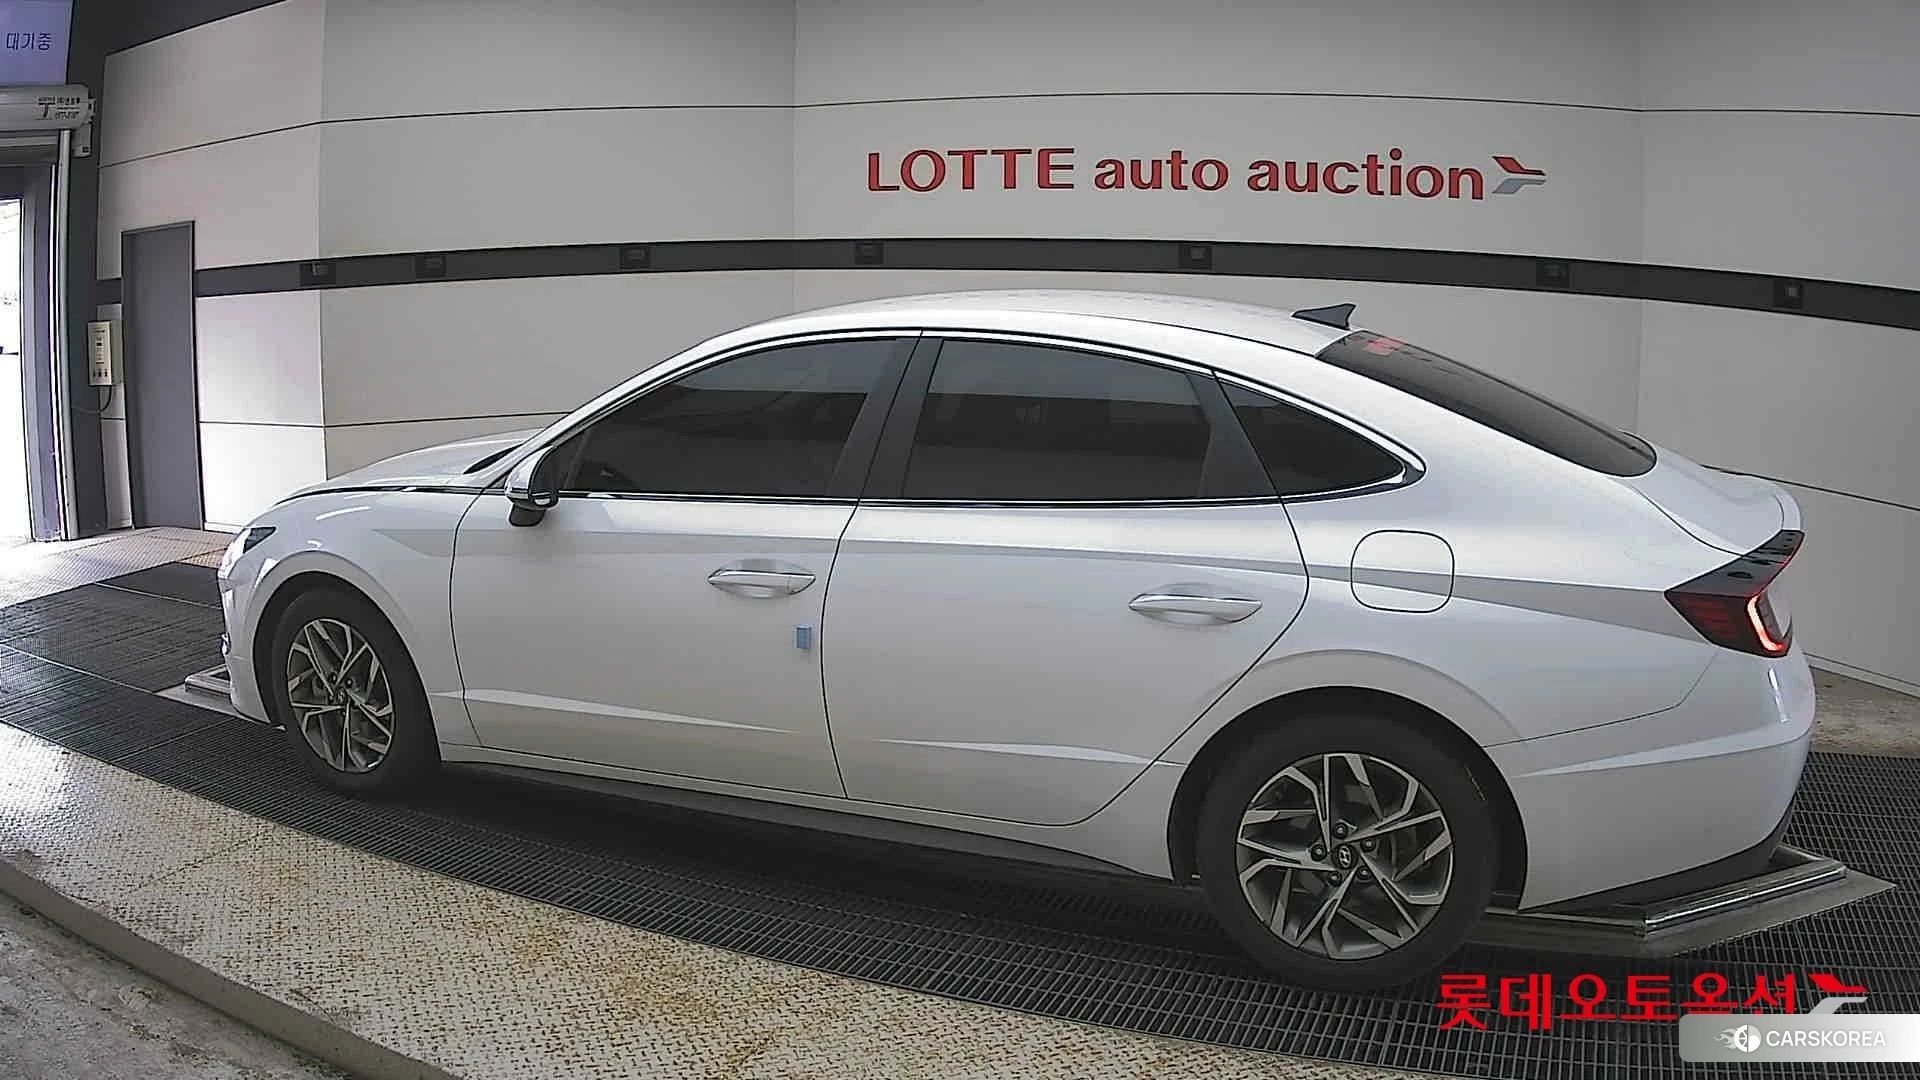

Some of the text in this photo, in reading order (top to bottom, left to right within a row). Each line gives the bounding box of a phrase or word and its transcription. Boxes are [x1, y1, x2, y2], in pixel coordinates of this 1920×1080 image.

[6, 32, 52, 51] 대기중
[867, 147, 1485, 201] LOTTE auto auction
